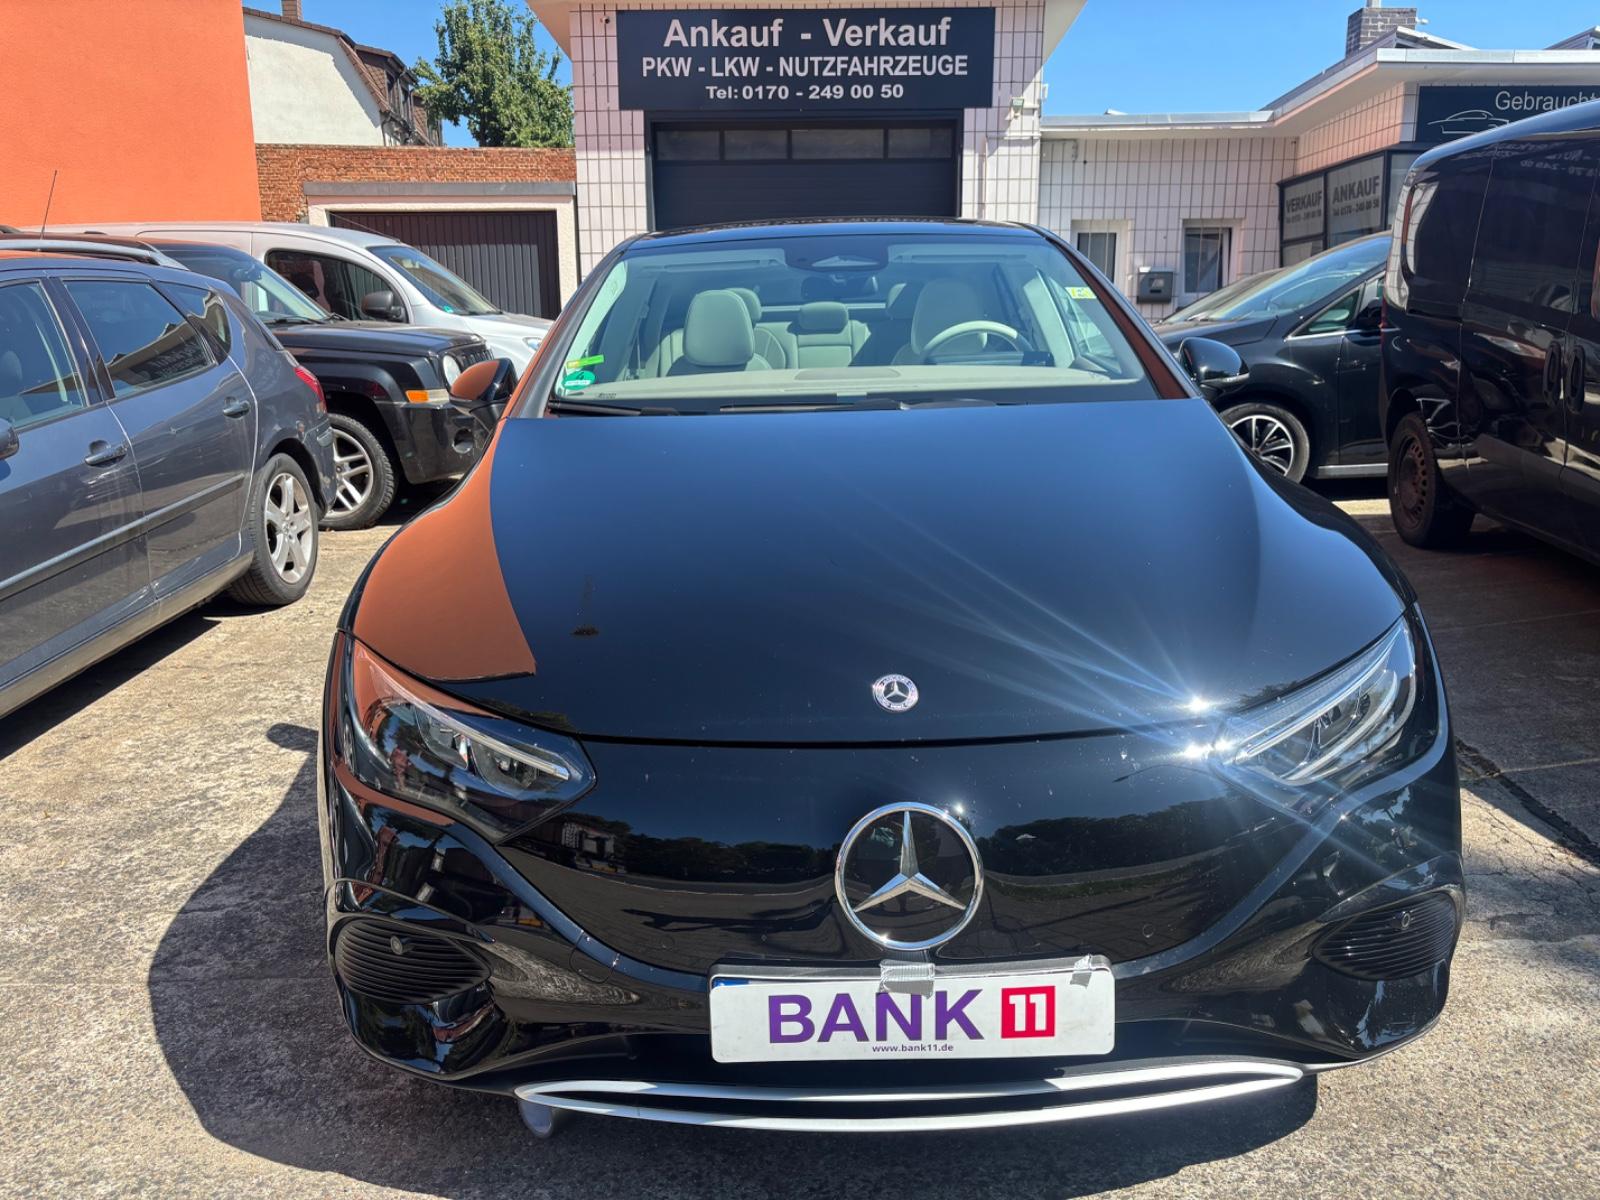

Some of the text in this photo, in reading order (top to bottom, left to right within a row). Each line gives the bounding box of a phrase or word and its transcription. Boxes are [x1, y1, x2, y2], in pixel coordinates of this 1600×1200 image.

[663, 16, 952, 47] Ankauf - Verkauf
[642, 56, 693, 77] PKW
[711, 56, 760, 77] LKW
[779, 55, 968, 77] NUTZFAHRZEUGE
[808, 84, 844, 99] 249
[850, 84, 874, 99] 00
[880, 83, 904, 98] 50
[1286, 190, 1322, 213] VERKAUF
[1332, 176, 1380, 204] ANKAUF
[768, 988, 1047, 1044] BANK 11
[872, 1043, 955, 1053] www.bank11.de
